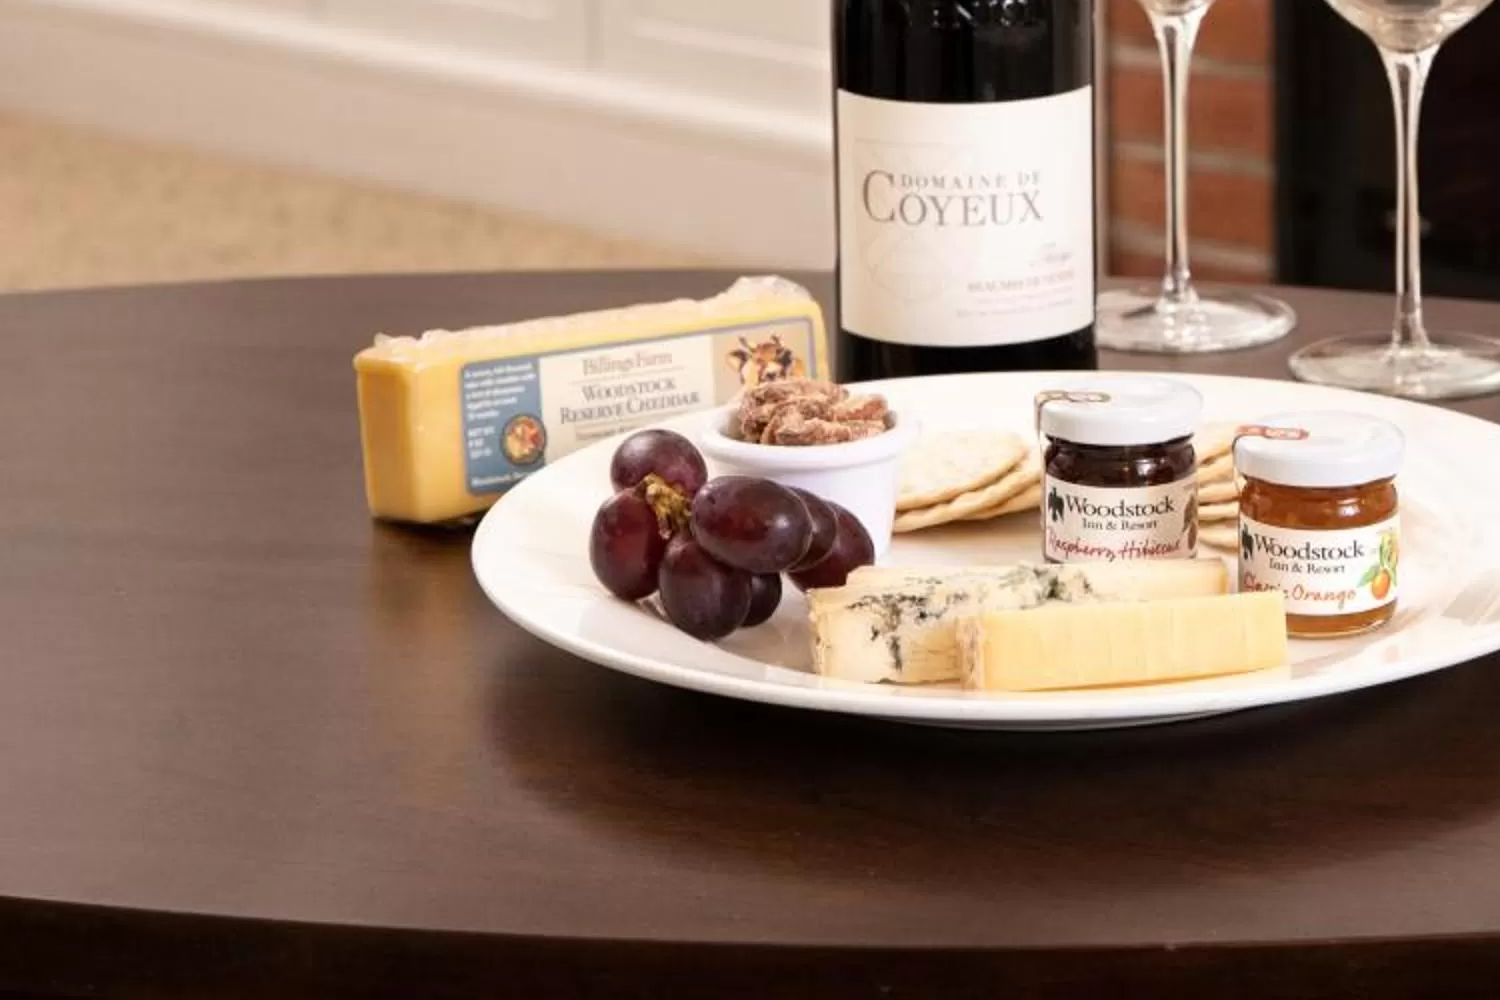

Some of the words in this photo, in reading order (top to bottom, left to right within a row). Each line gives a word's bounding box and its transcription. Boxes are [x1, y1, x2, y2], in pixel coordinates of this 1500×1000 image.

[900, 172, 1007, 189] DOMAINE
[1017, 169, 1042, 186] DE
[862, 169, 1044, 227] COYEUX
[580, 377, 678, 402] WOODSTOCK
[559, 403, 625, 425] RESERVE
[626, 391, 701, 415] CHEDDAR
[1064, 494, 1175, 519] Woodstock
[1082, 518, 1103, 531] Inn
[1105, 521, 1117, 531] &
[1120, 519, 1158, 531] Resort
[1253, 532, 1365, 562] Woodstock
[1269, 557, 1291, 573] Inn
[1292, 562, 1303, 573] &
[1307, 562, 1345, 574] Resort
[1291, 584, 1357, 610] Orange
